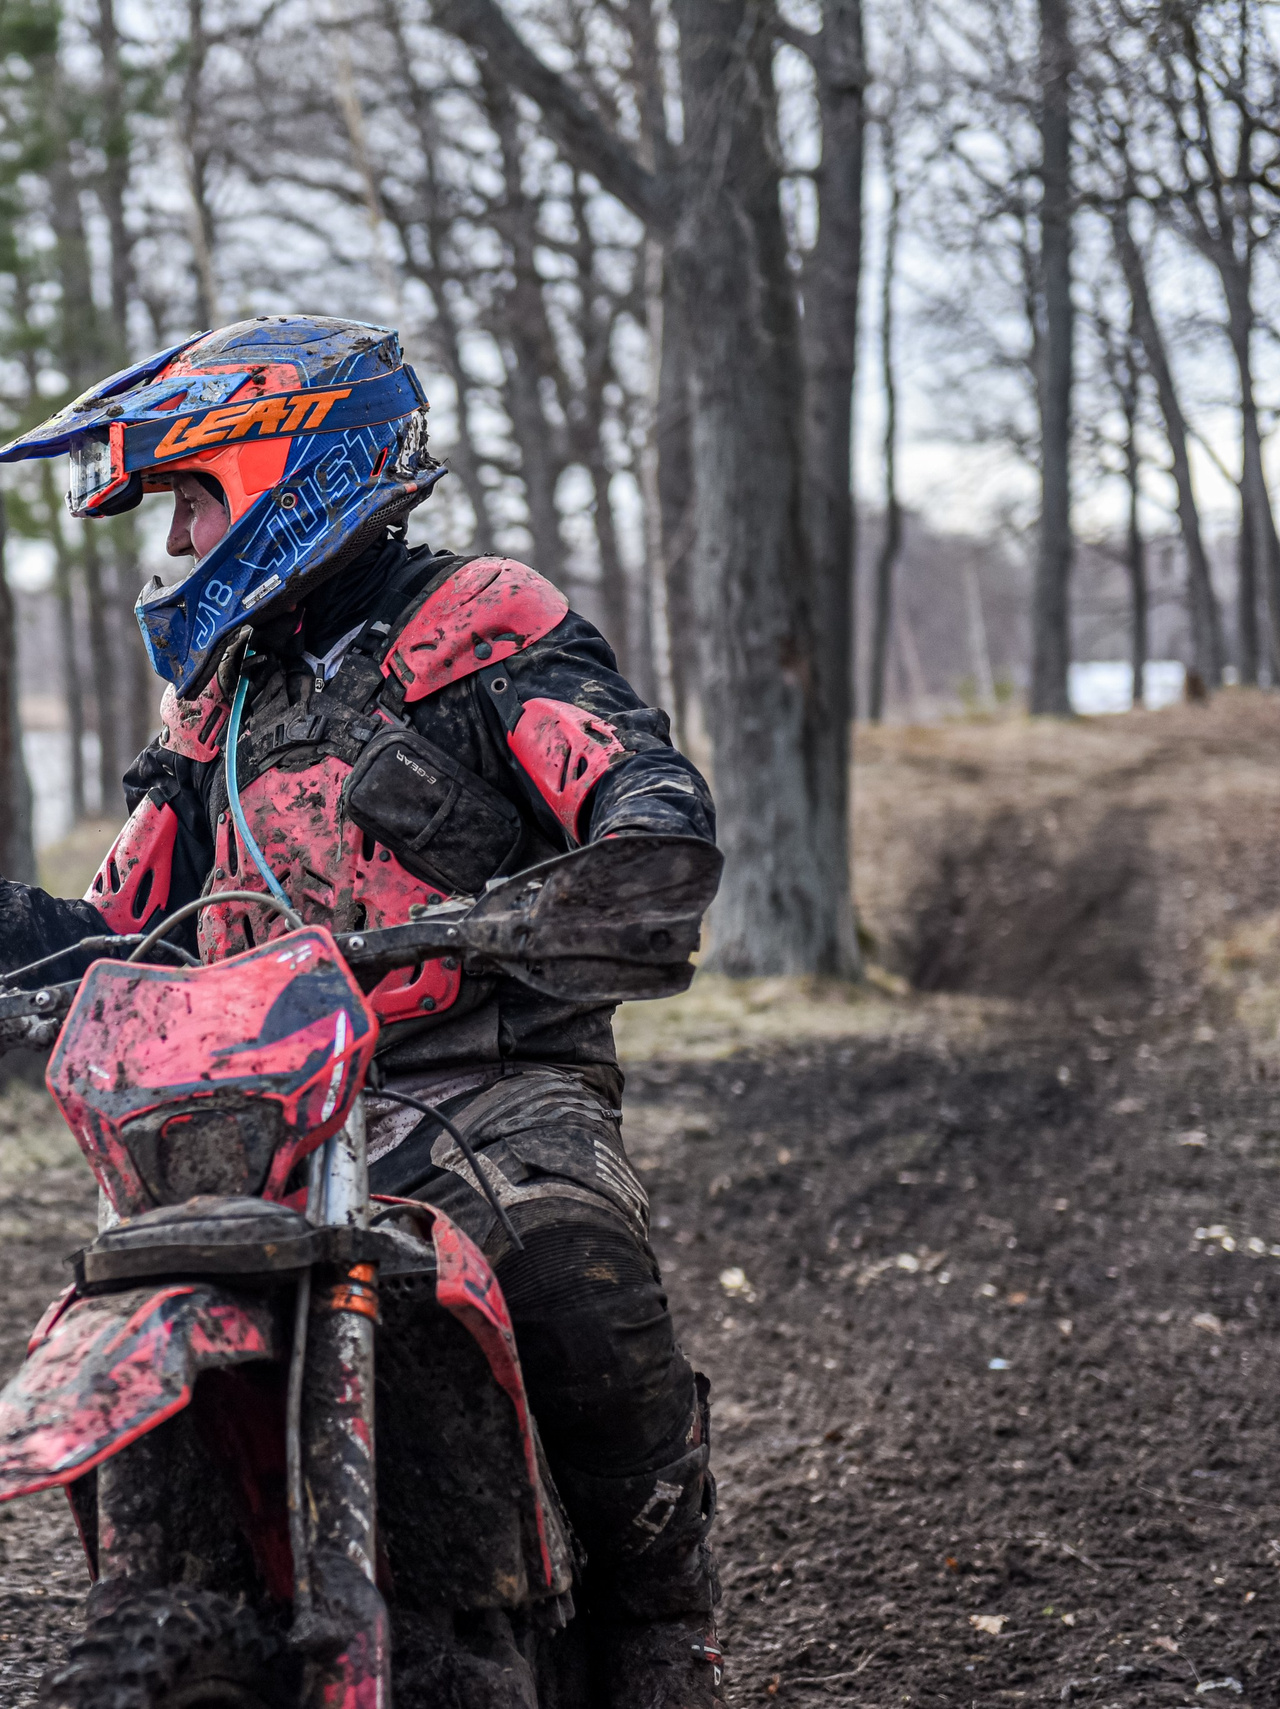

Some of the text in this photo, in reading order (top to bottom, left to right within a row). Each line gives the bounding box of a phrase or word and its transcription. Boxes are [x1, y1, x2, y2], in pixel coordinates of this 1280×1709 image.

[153, 388, 353, 459] LEATT
[195, 579, 233, 650] J18
[396, 749, 437, 785] E-GEAR
